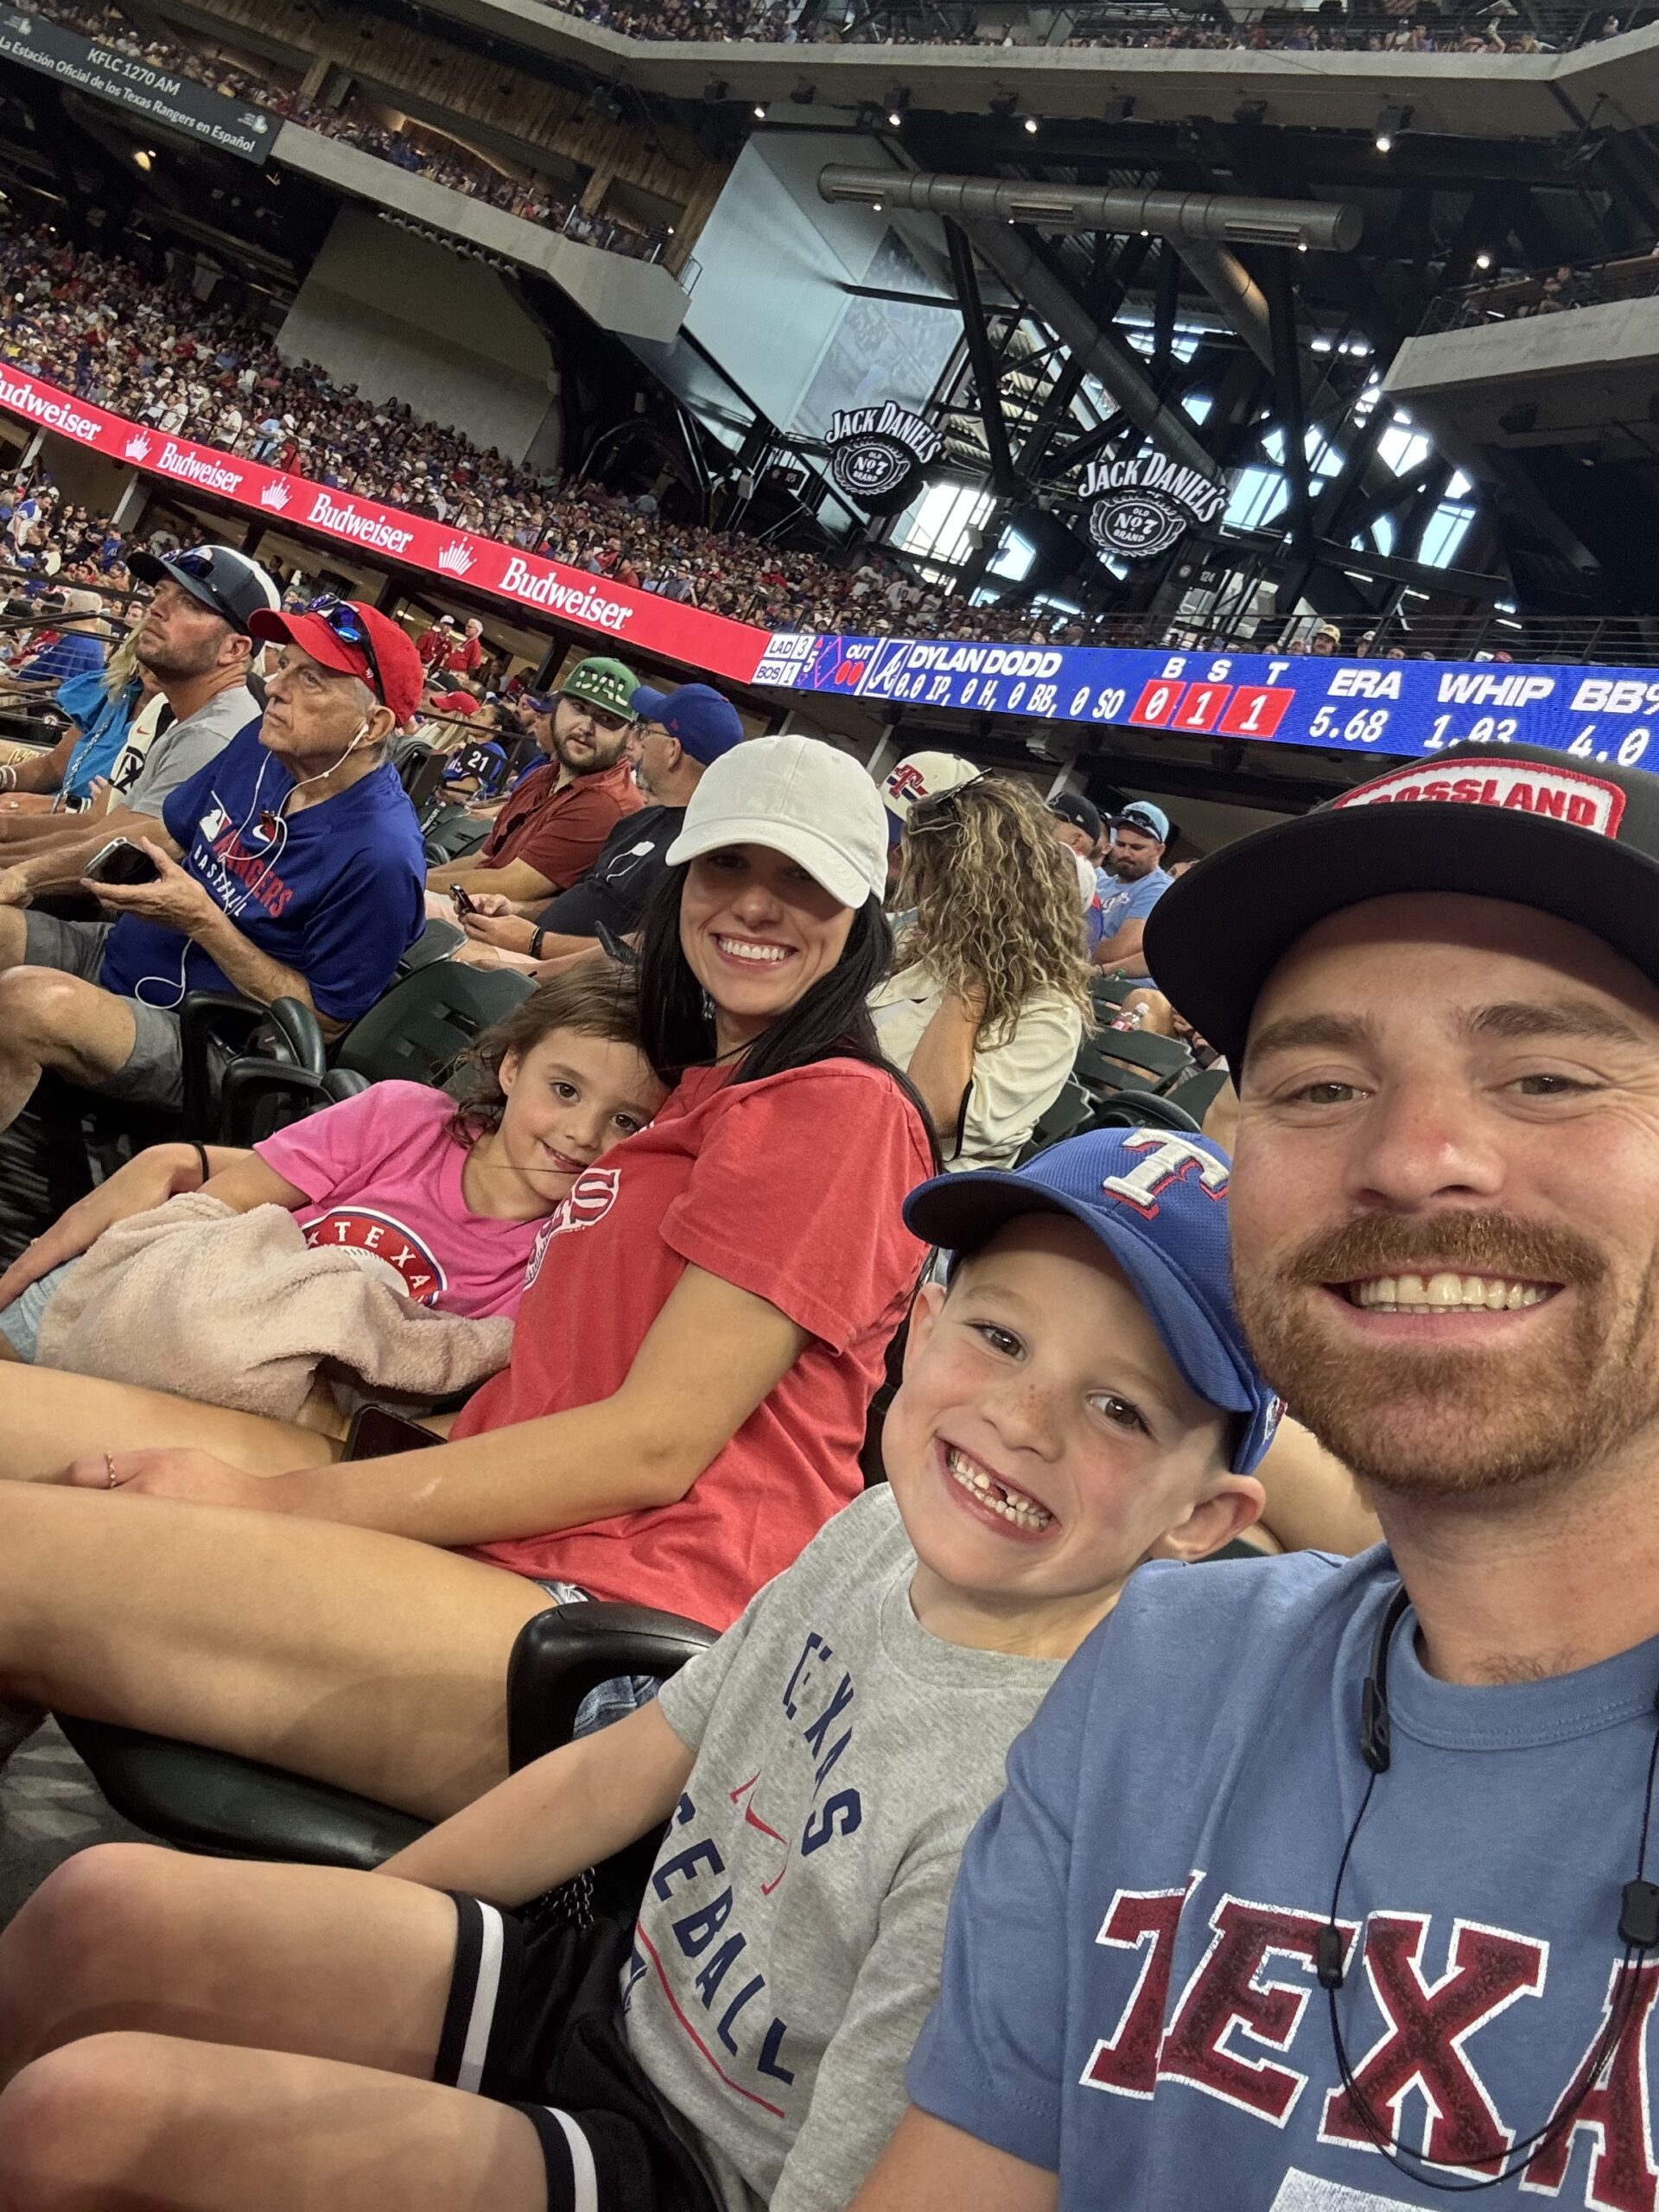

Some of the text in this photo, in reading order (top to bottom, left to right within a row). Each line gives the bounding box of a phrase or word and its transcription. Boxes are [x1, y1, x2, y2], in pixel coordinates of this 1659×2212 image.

[87, 48, 181, 96] KFLC 1270 AM
[12, 41, 54, 68] Estación
[55, 60, 91, 84] Oficial
[91, 75, 105, 90] de
[105, 79, 121, 97] los
[123, 86, 152, 109] Texas
[152, 99, 196, 128] Rangers
[196, 121, 211, 135] en
[211, 125, 256, 153] Español
[825, 402, 943, 464] JACK DANIEL'S
[156, 442, 244, 493] Budweiser
[852, 470, 878, 482] BRAND
[1077, 452, 1226, 523] JACK DANIEL'S
[307, 493, 414, 553] Budweiser
[1133, 507, 1150, 517] OLD
[1113, 529, 1145, 543] BRAND
[498, 556, 633, 631] Budweiser
[769, 638, 810, 657] LAD 3
[804, 651, 819, 673] 5
[846, 644, 875, 660] OUT
[907, 645, 1063, 678] DYLAN DODD
[575, 665, 629, 708] DAL
[756, 664, 796, 683] BOS 1
[1161, 657, 1290, 685] B S T
[1327, 668, 1402, 700] ERA
[1437, 672, 1555, 708] WHIP
[893, 673, 1126, 720] 0.0 IP, 0 H, 0 BB, 0 SO
[1145, 687, 1268, 731] 0 1 1
[1309, 706, 1389, 743] 5.68
[467, 750, 489, 772] 21
[1567, 724, 1650, 767] 4.0
[1370, 779, 1598, 826] OSSLAND
[334, 1221, 431, 1303] TEXA
